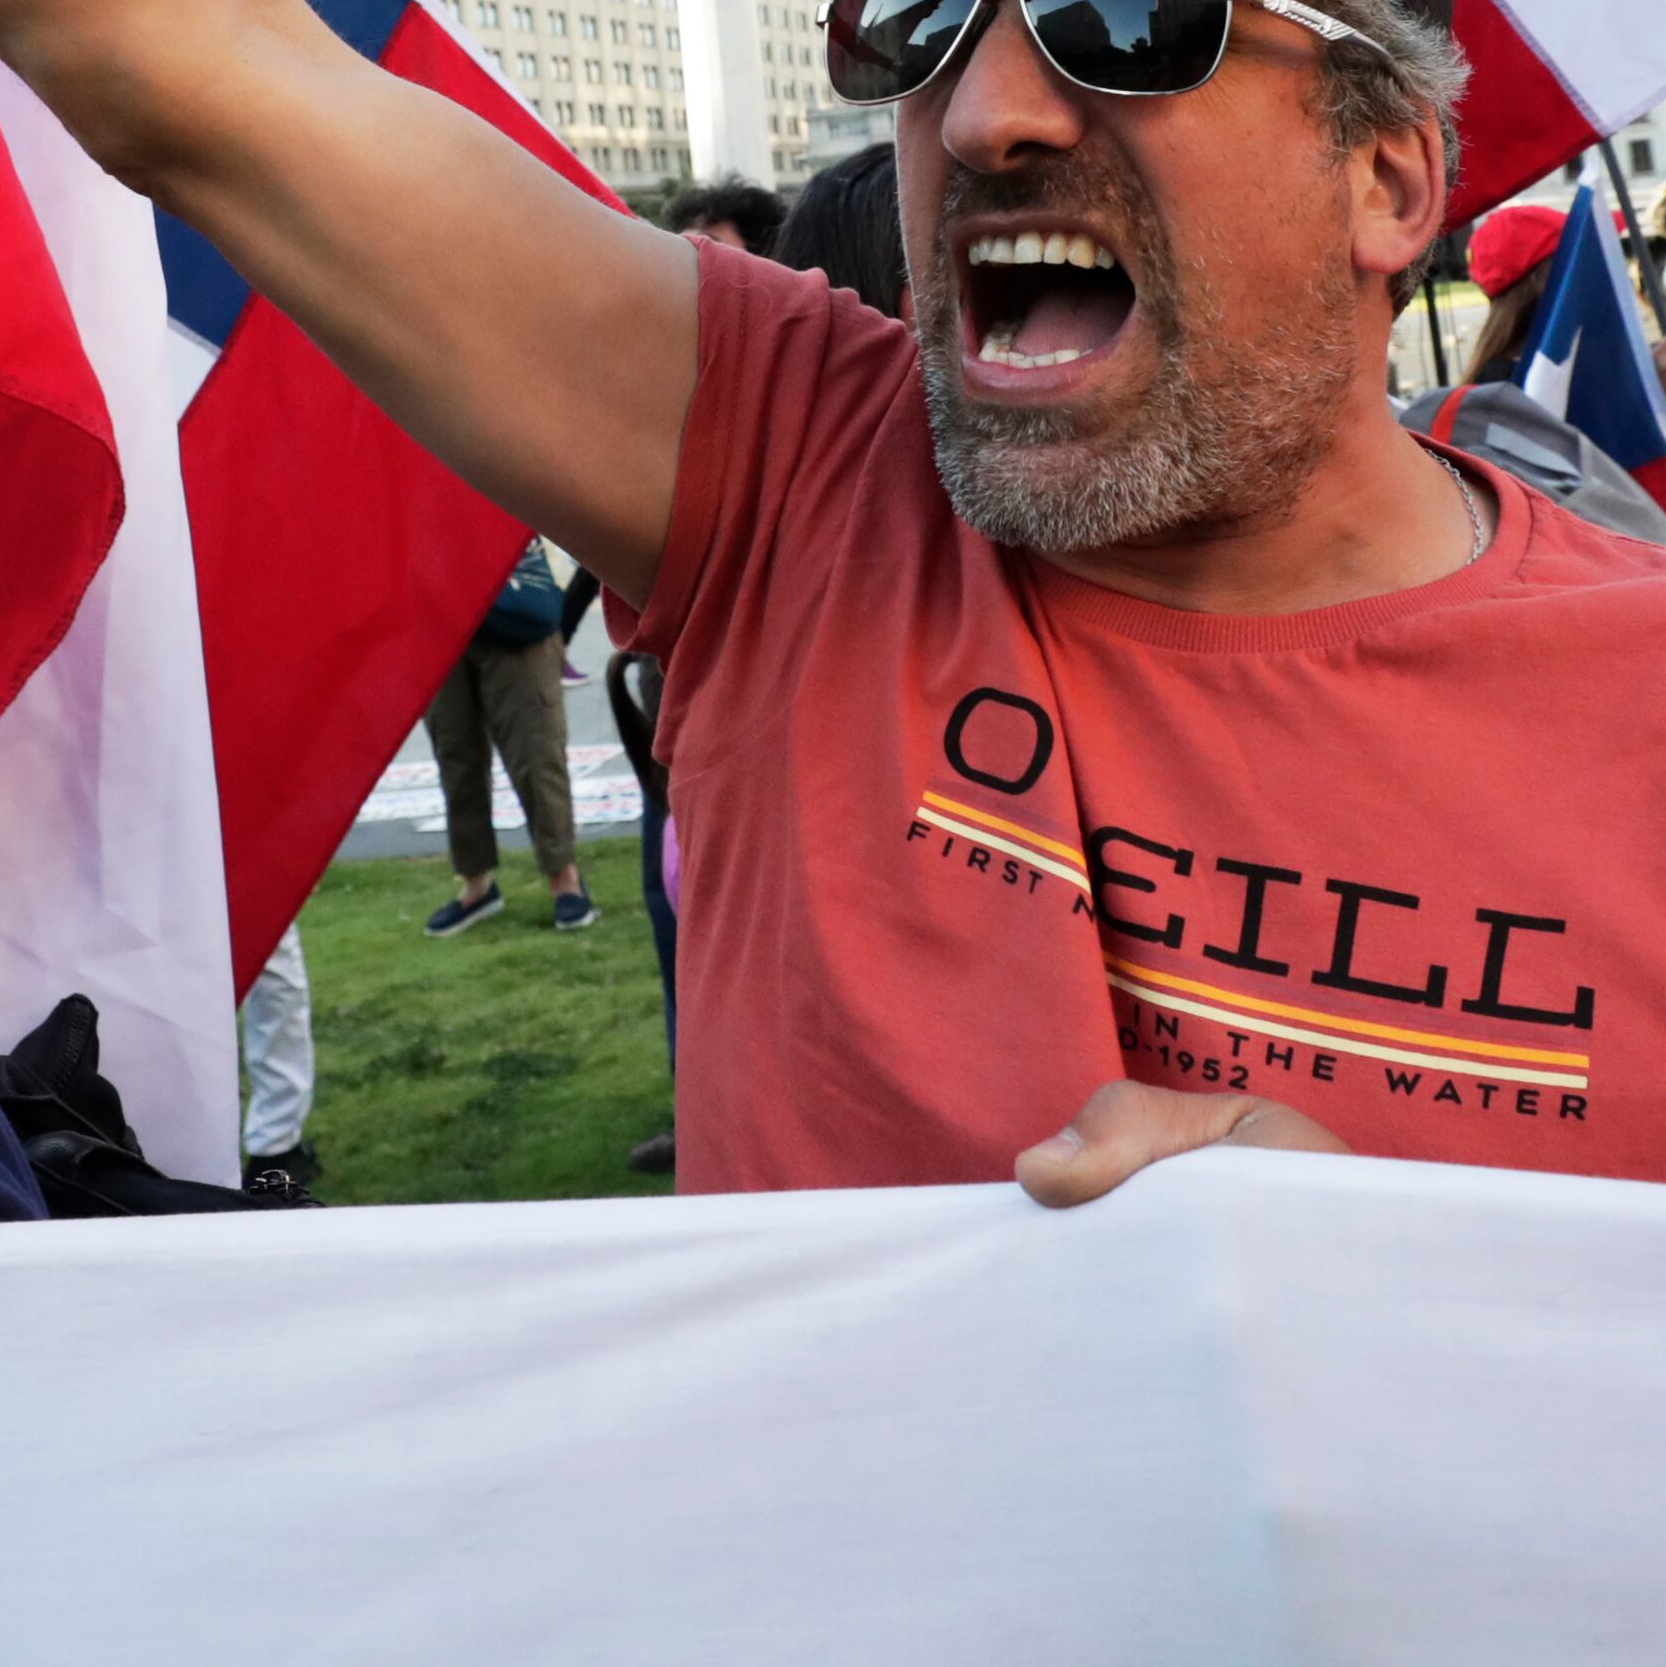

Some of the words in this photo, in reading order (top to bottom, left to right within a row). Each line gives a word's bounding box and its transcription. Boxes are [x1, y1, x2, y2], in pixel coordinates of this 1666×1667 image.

[907, 820, 1043, 894] FIRST
[1134, 1004, 1179, 1040] IN
[1227, 1031, 1337, 1082] THE
[1385, 1067, 1588, 1121] WATER
